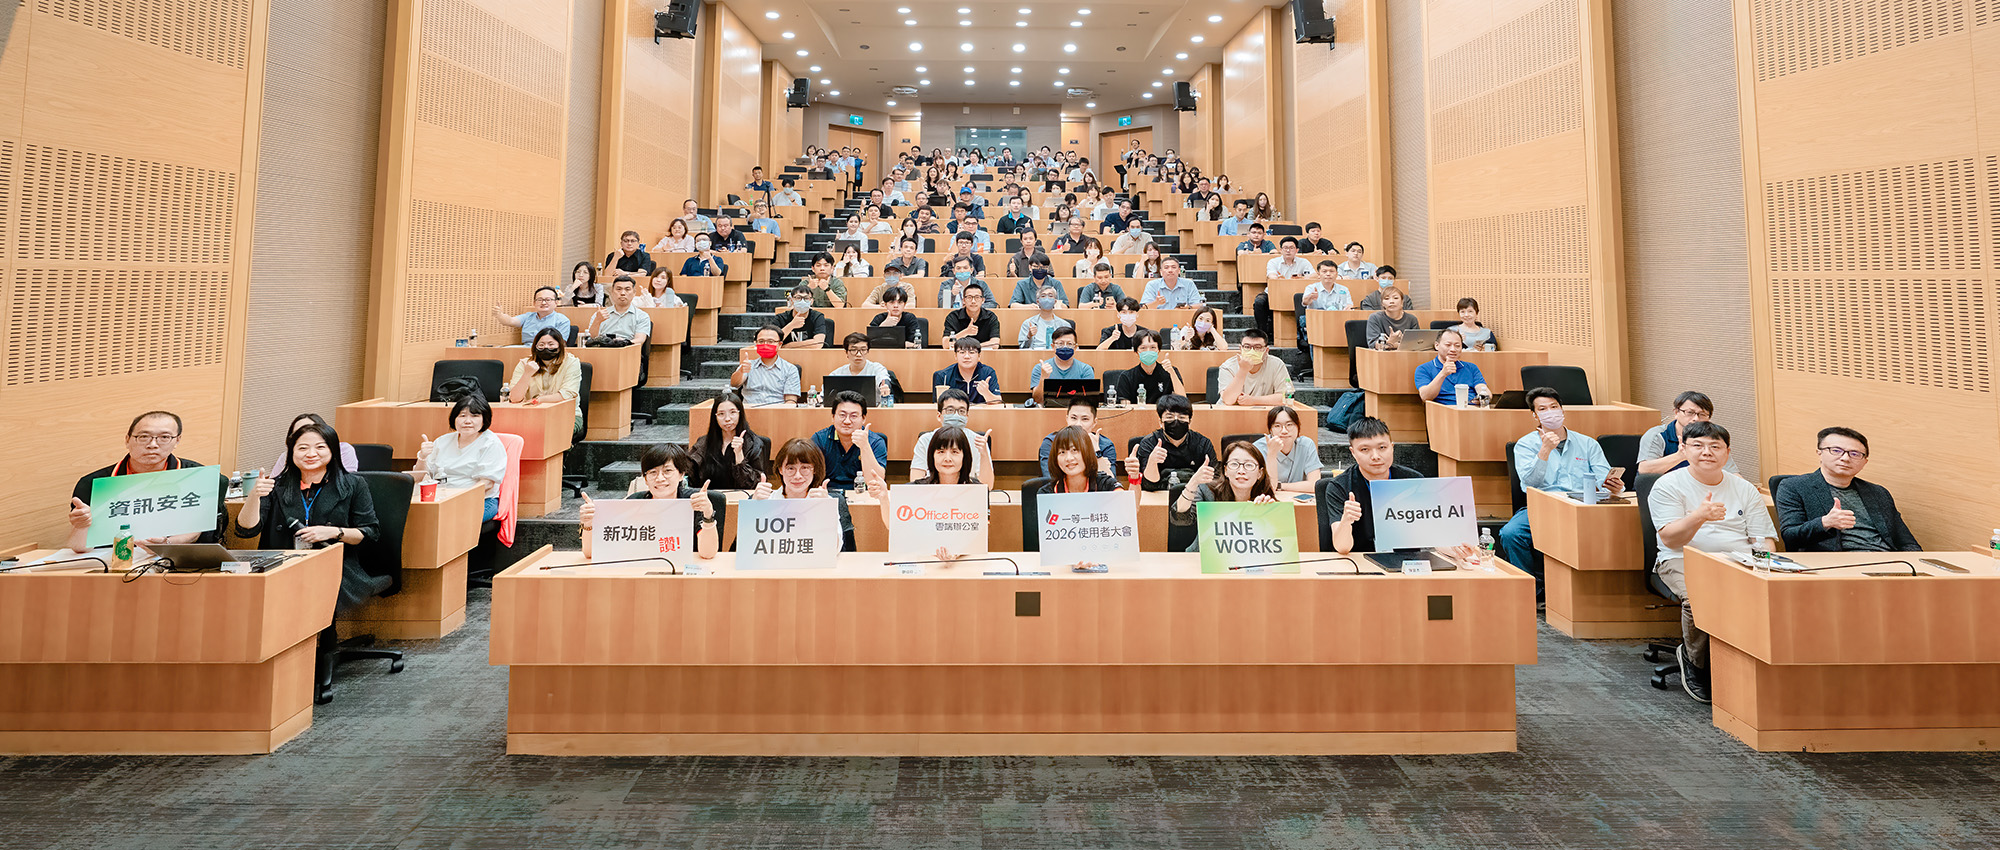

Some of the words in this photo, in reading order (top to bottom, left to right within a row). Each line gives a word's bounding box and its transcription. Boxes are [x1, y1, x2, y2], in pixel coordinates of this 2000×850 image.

[108, 491, 201, 518] 資訊安全
[914, 507, 949, 521] Office
[950, 508, 979, 520] Force
[1062, 513, 1109, 523] 一等一科技
[1385, 505, 1442, 523] Asgard
[1448, 505, 1465, 518] AI
[603, 525, 656, 541] 新功能
[755, 517, 796, 533] UOF
[1214, 521, 1254, 536] LINE
[658, 536, 681, 553] 讚!
[1214, 539, 1283, 553] WORKS
